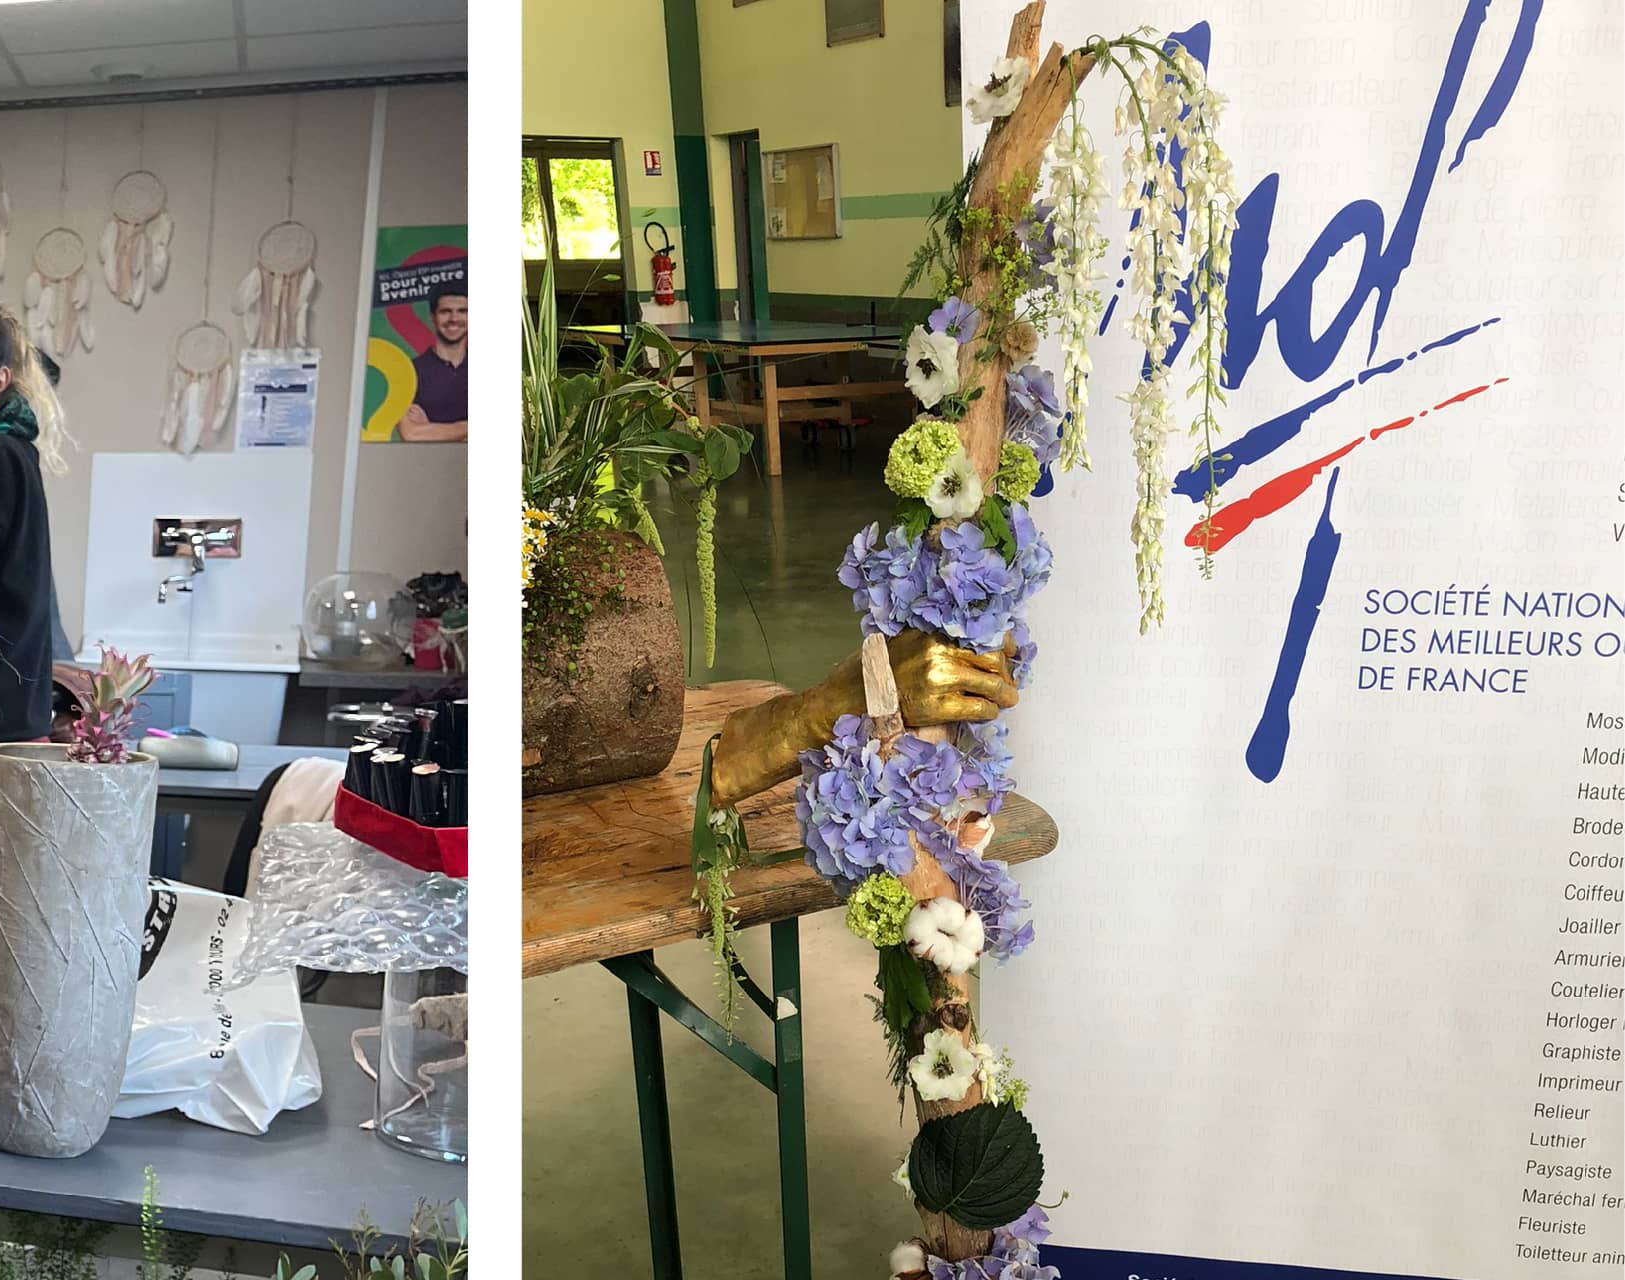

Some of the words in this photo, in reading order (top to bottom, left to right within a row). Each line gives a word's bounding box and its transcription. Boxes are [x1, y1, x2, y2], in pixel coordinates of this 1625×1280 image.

[380, 278, 418, 292] pour
[422, 270, 464, 284] votre
[381, 284, 431, 301] avenir
[1363, 583, 1491, 616] SOCIÉTÉ
[1361, 627, 1417, 654] DES
[1427, 629, 1583, 657] MEILLEURS
[1358, 665, 1396, 690] DE
[1407, 667, 1529, 693] FRANCE
[1558, 917, 1622, 935] Joailler
[1551, 981, 1624, 999] Coutelier
[1546, 1012, 1617, 1032] Horloger
[1542, 1042, 1621, 1062] Graphiste
[1538, 1073, 1623, 1092] Imprimeur
[1534, 1103, 1591, 1120] Relieur
[1529, 1132, 1587, 1149] Luthier
[1526, 1159, 1612, 1180] Paysagiste
[1522, 1189, 1596, 1208] Maréchal
[1518, 1216, 1587, 1235] Fleuriste
[1515, 1244, 1588, 1263] Toiletteur
